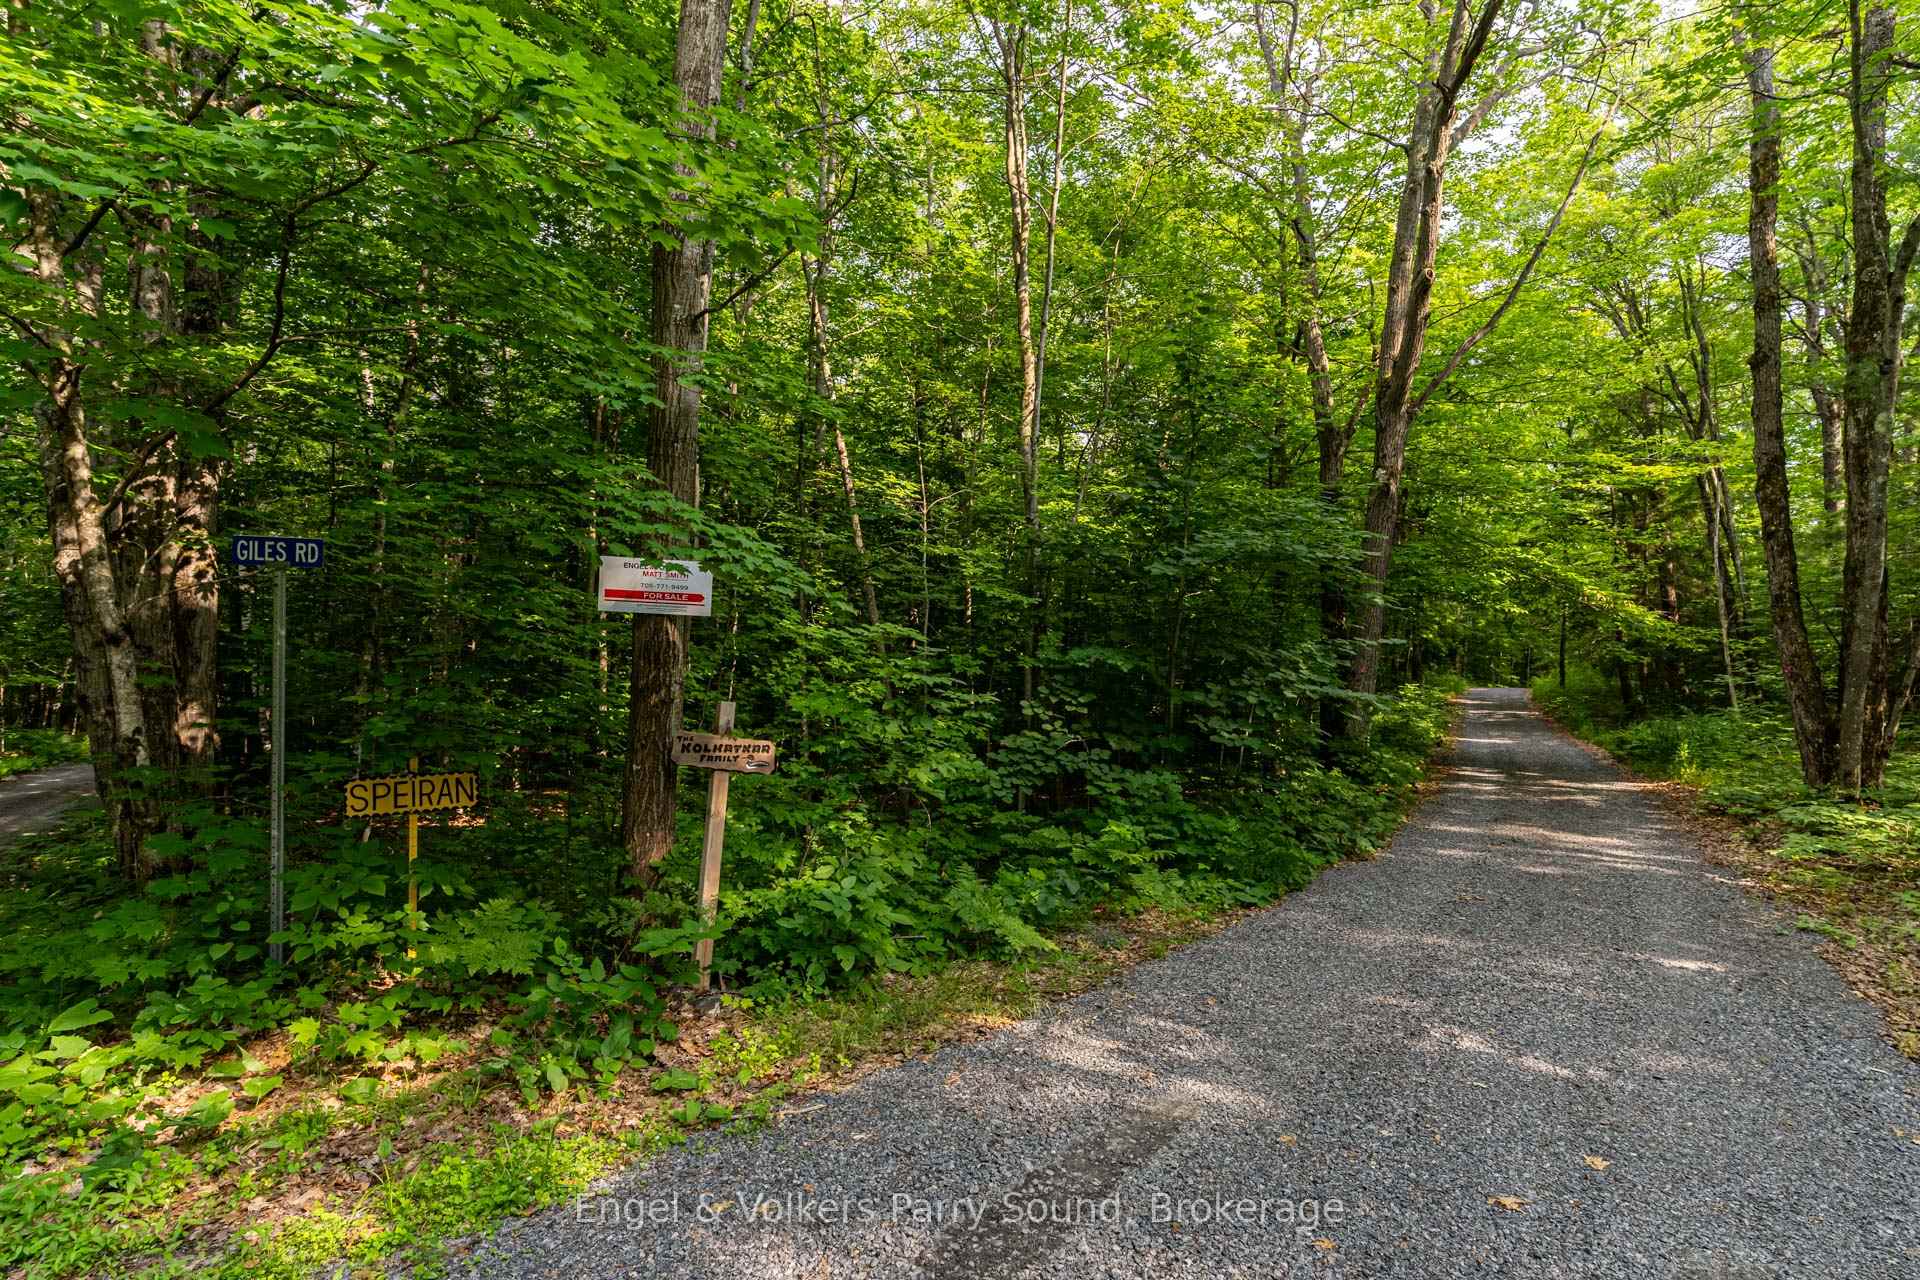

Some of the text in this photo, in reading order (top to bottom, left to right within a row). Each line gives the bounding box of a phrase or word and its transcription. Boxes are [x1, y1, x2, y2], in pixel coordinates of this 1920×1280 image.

[236, 540, 319, 563] GILES RD
[643, 592, 689, 601] FOR SALE
[699, 754, 740, 762] FAMILY
[349, 776, 475, 812] SPEIRAN
